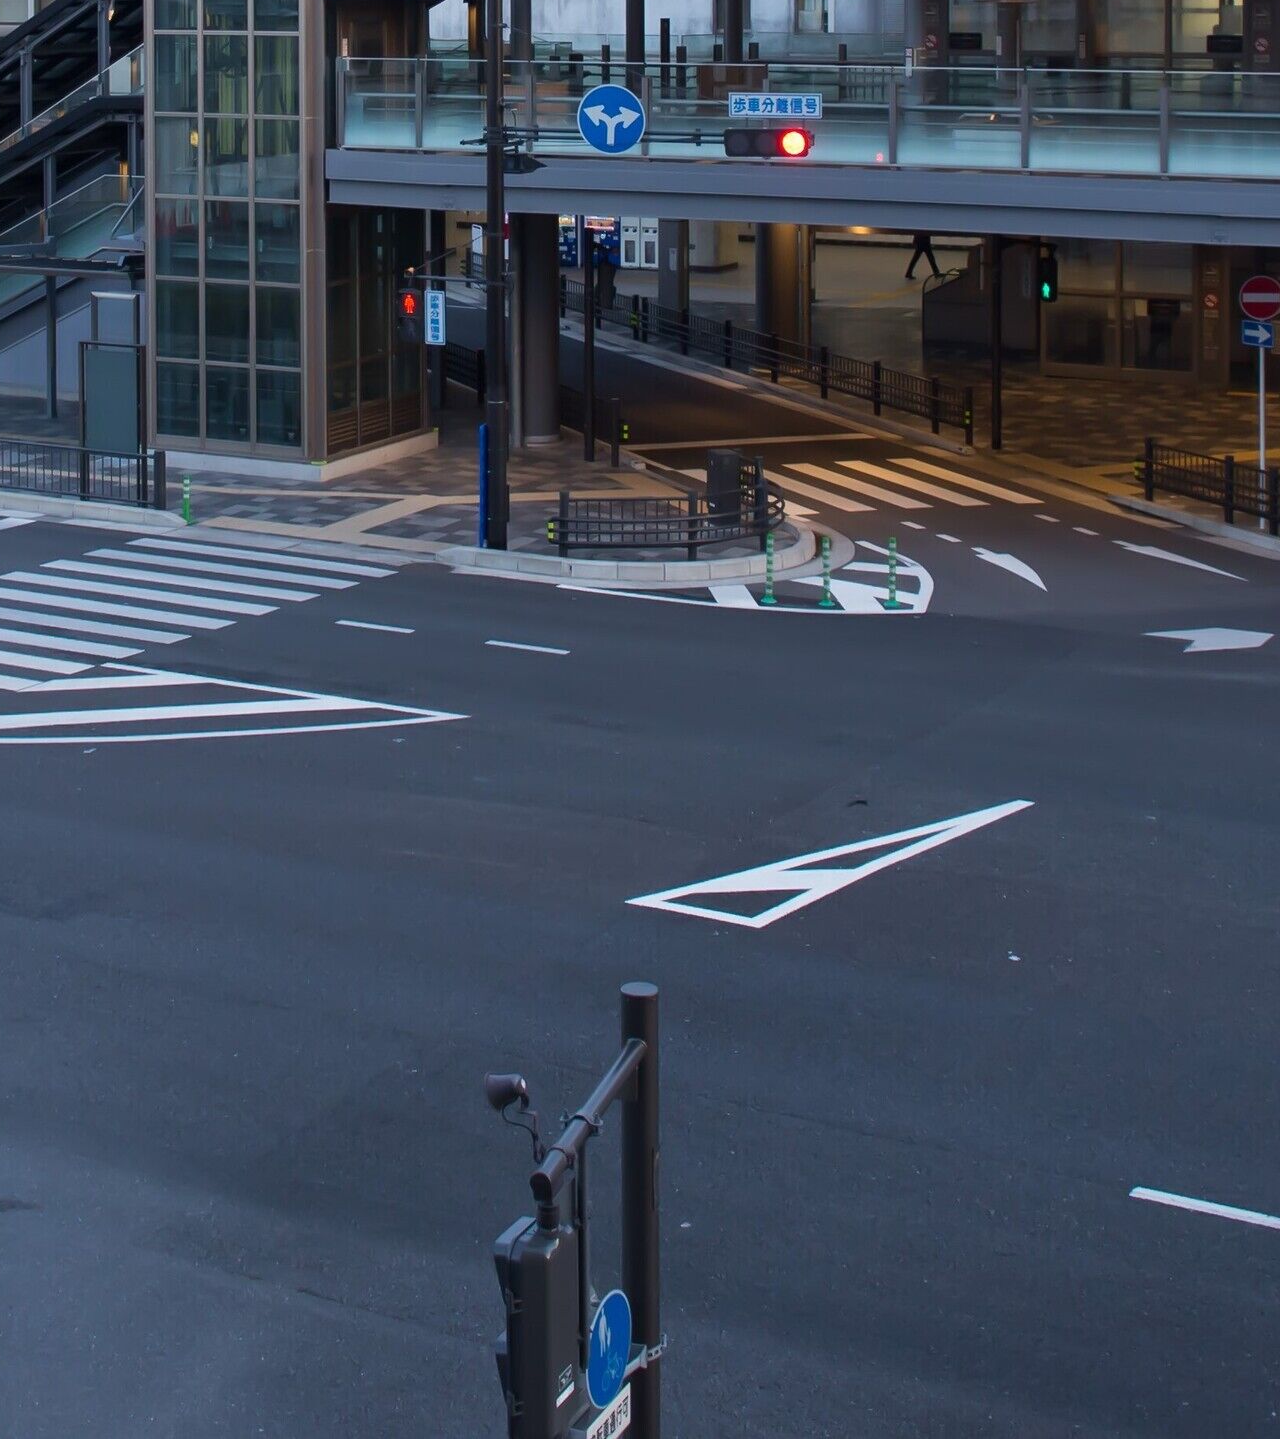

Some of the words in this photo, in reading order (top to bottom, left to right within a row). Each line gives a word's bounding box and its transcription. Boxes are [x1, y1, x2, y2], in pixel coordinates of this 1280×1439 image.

[733, 97, 818, 114] 歩車分離信号
